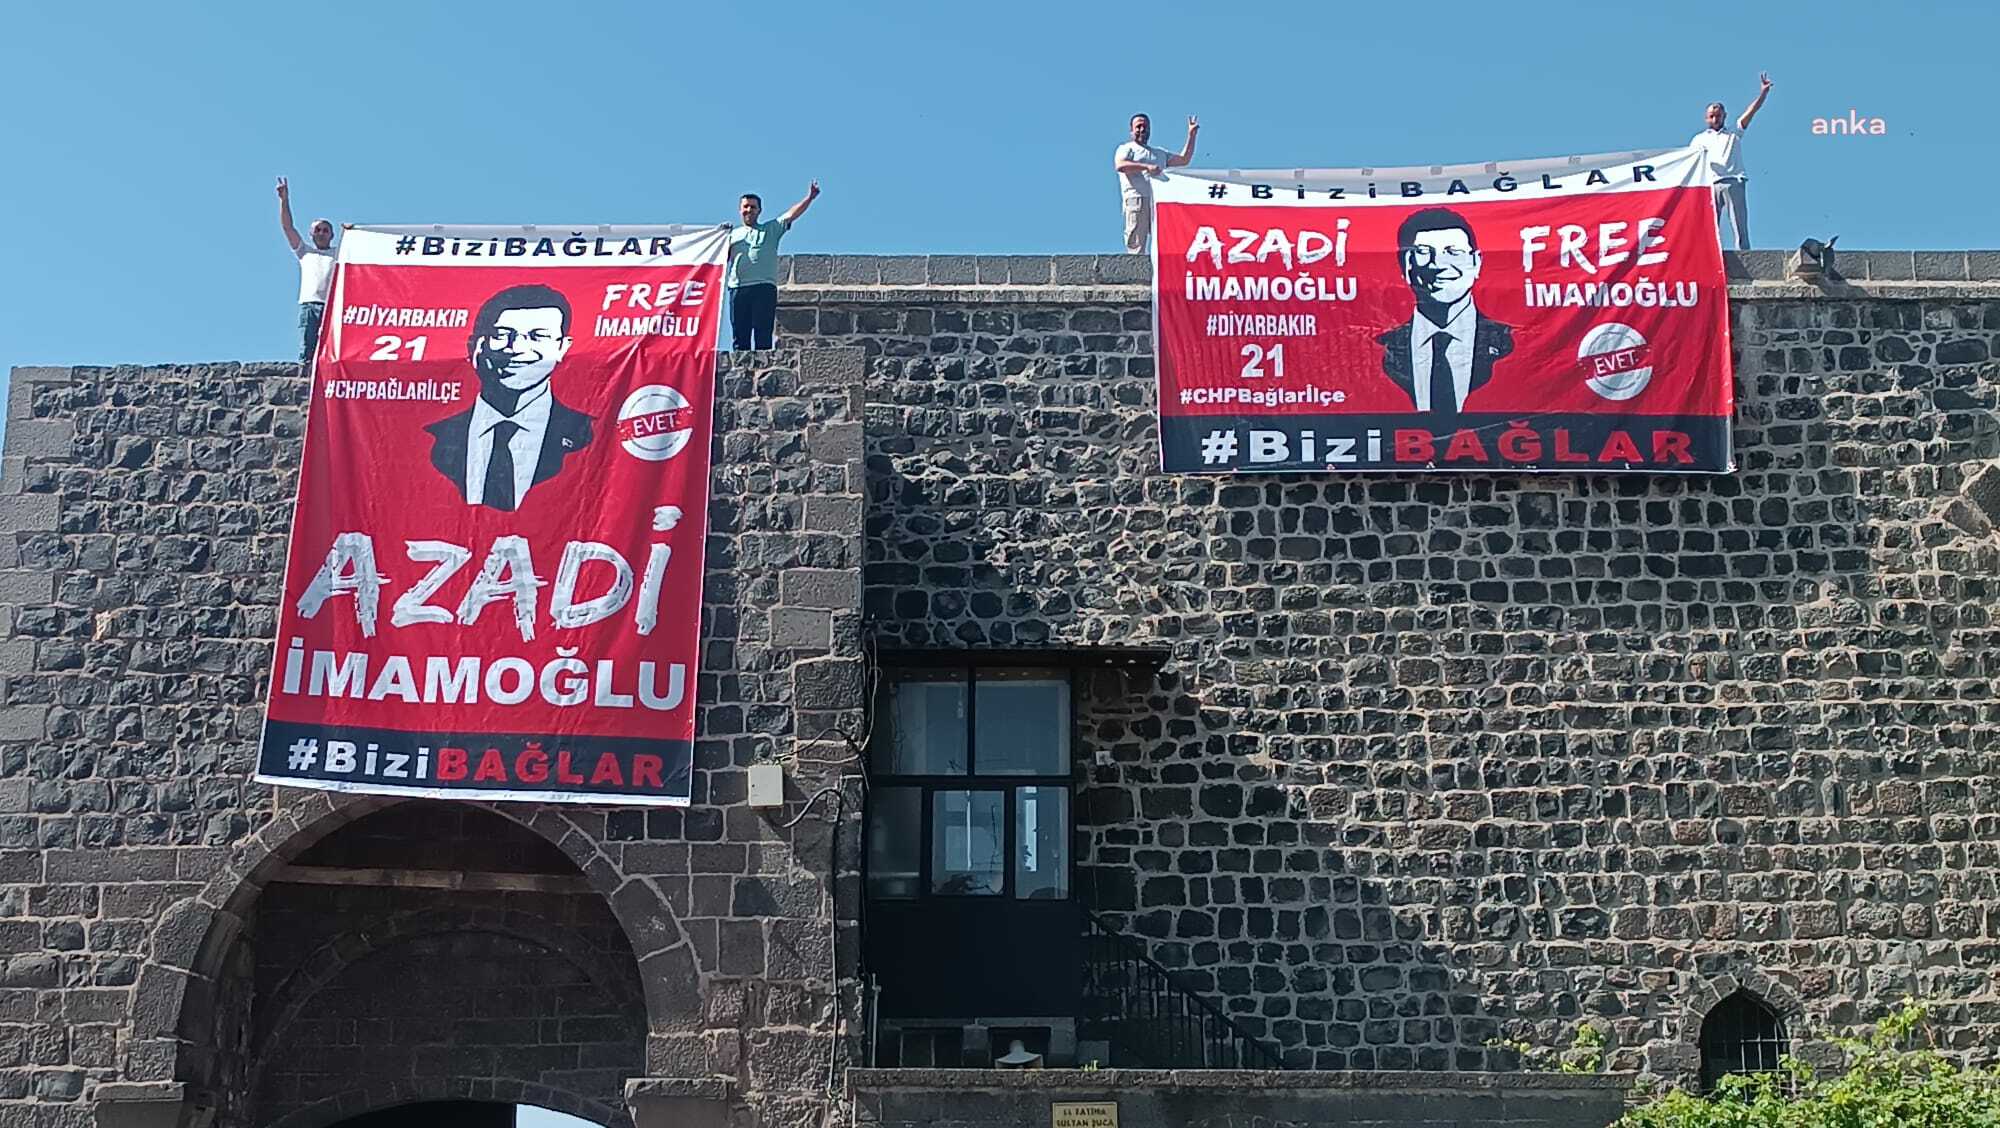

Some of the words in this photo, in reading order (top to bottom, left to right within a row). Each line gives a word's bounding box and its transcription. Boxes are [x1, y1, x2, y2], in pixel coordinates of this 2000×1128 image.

[396, 231, 673, 258] #BiziBAĞLAR
[1185, 218, 1350, 271] AZADİ
[1521, 216, 1670, 275] FREE
[602, 280, 706, 312] FREE
[1186, 271, 1358, 302] İMAMOĞLU
[1524, 275, 1699, 308] İMAMOĞLU
[343, 303, 467, 328] #DİYARBAKIR
[594, 310, 700, 338] İMAMOĞLU
[1206, 310, 1317, 337] #DİYARBAKIR
[368, 335, 428, 362] 21
[1240, 343, 1285, 379] 21
[1594, 349, 1636, 375] EVET
[324, 376, 462, 404] #CHPBAĞLARİLÇE
[1179, 383, 1345, 407] #CHPBağlarİlçe
[633, 411, 677, 436] EVET
[1201, 420, 1694, 465] #BiziBAĞLAR
[296, 505, 684, 643] AZADİ
[281, 636, 687, 711] İMAMOĞLU
[287, 737, 665, 788] #BiziBAĞLAR
